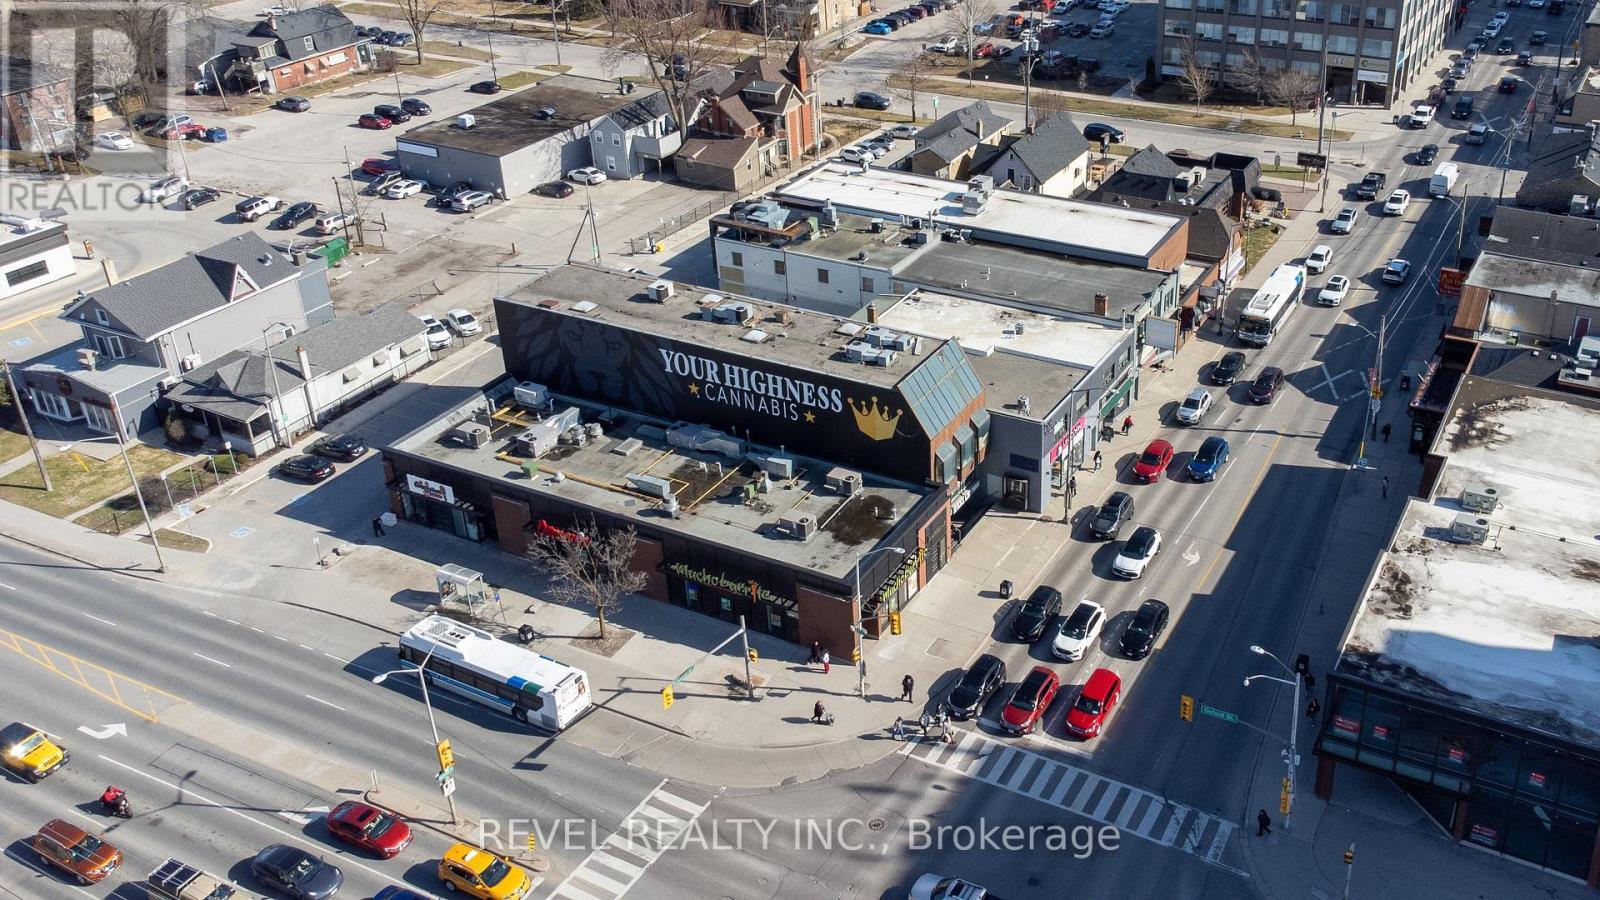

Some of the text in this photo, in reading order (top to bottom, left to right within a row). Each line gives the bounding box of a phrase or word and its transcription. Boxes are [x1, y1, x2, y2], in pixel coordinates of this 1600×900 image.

[658, 348, 843, 413] YOUR HIGHNESS
[705, 383, 799, 421] CANNABIS
